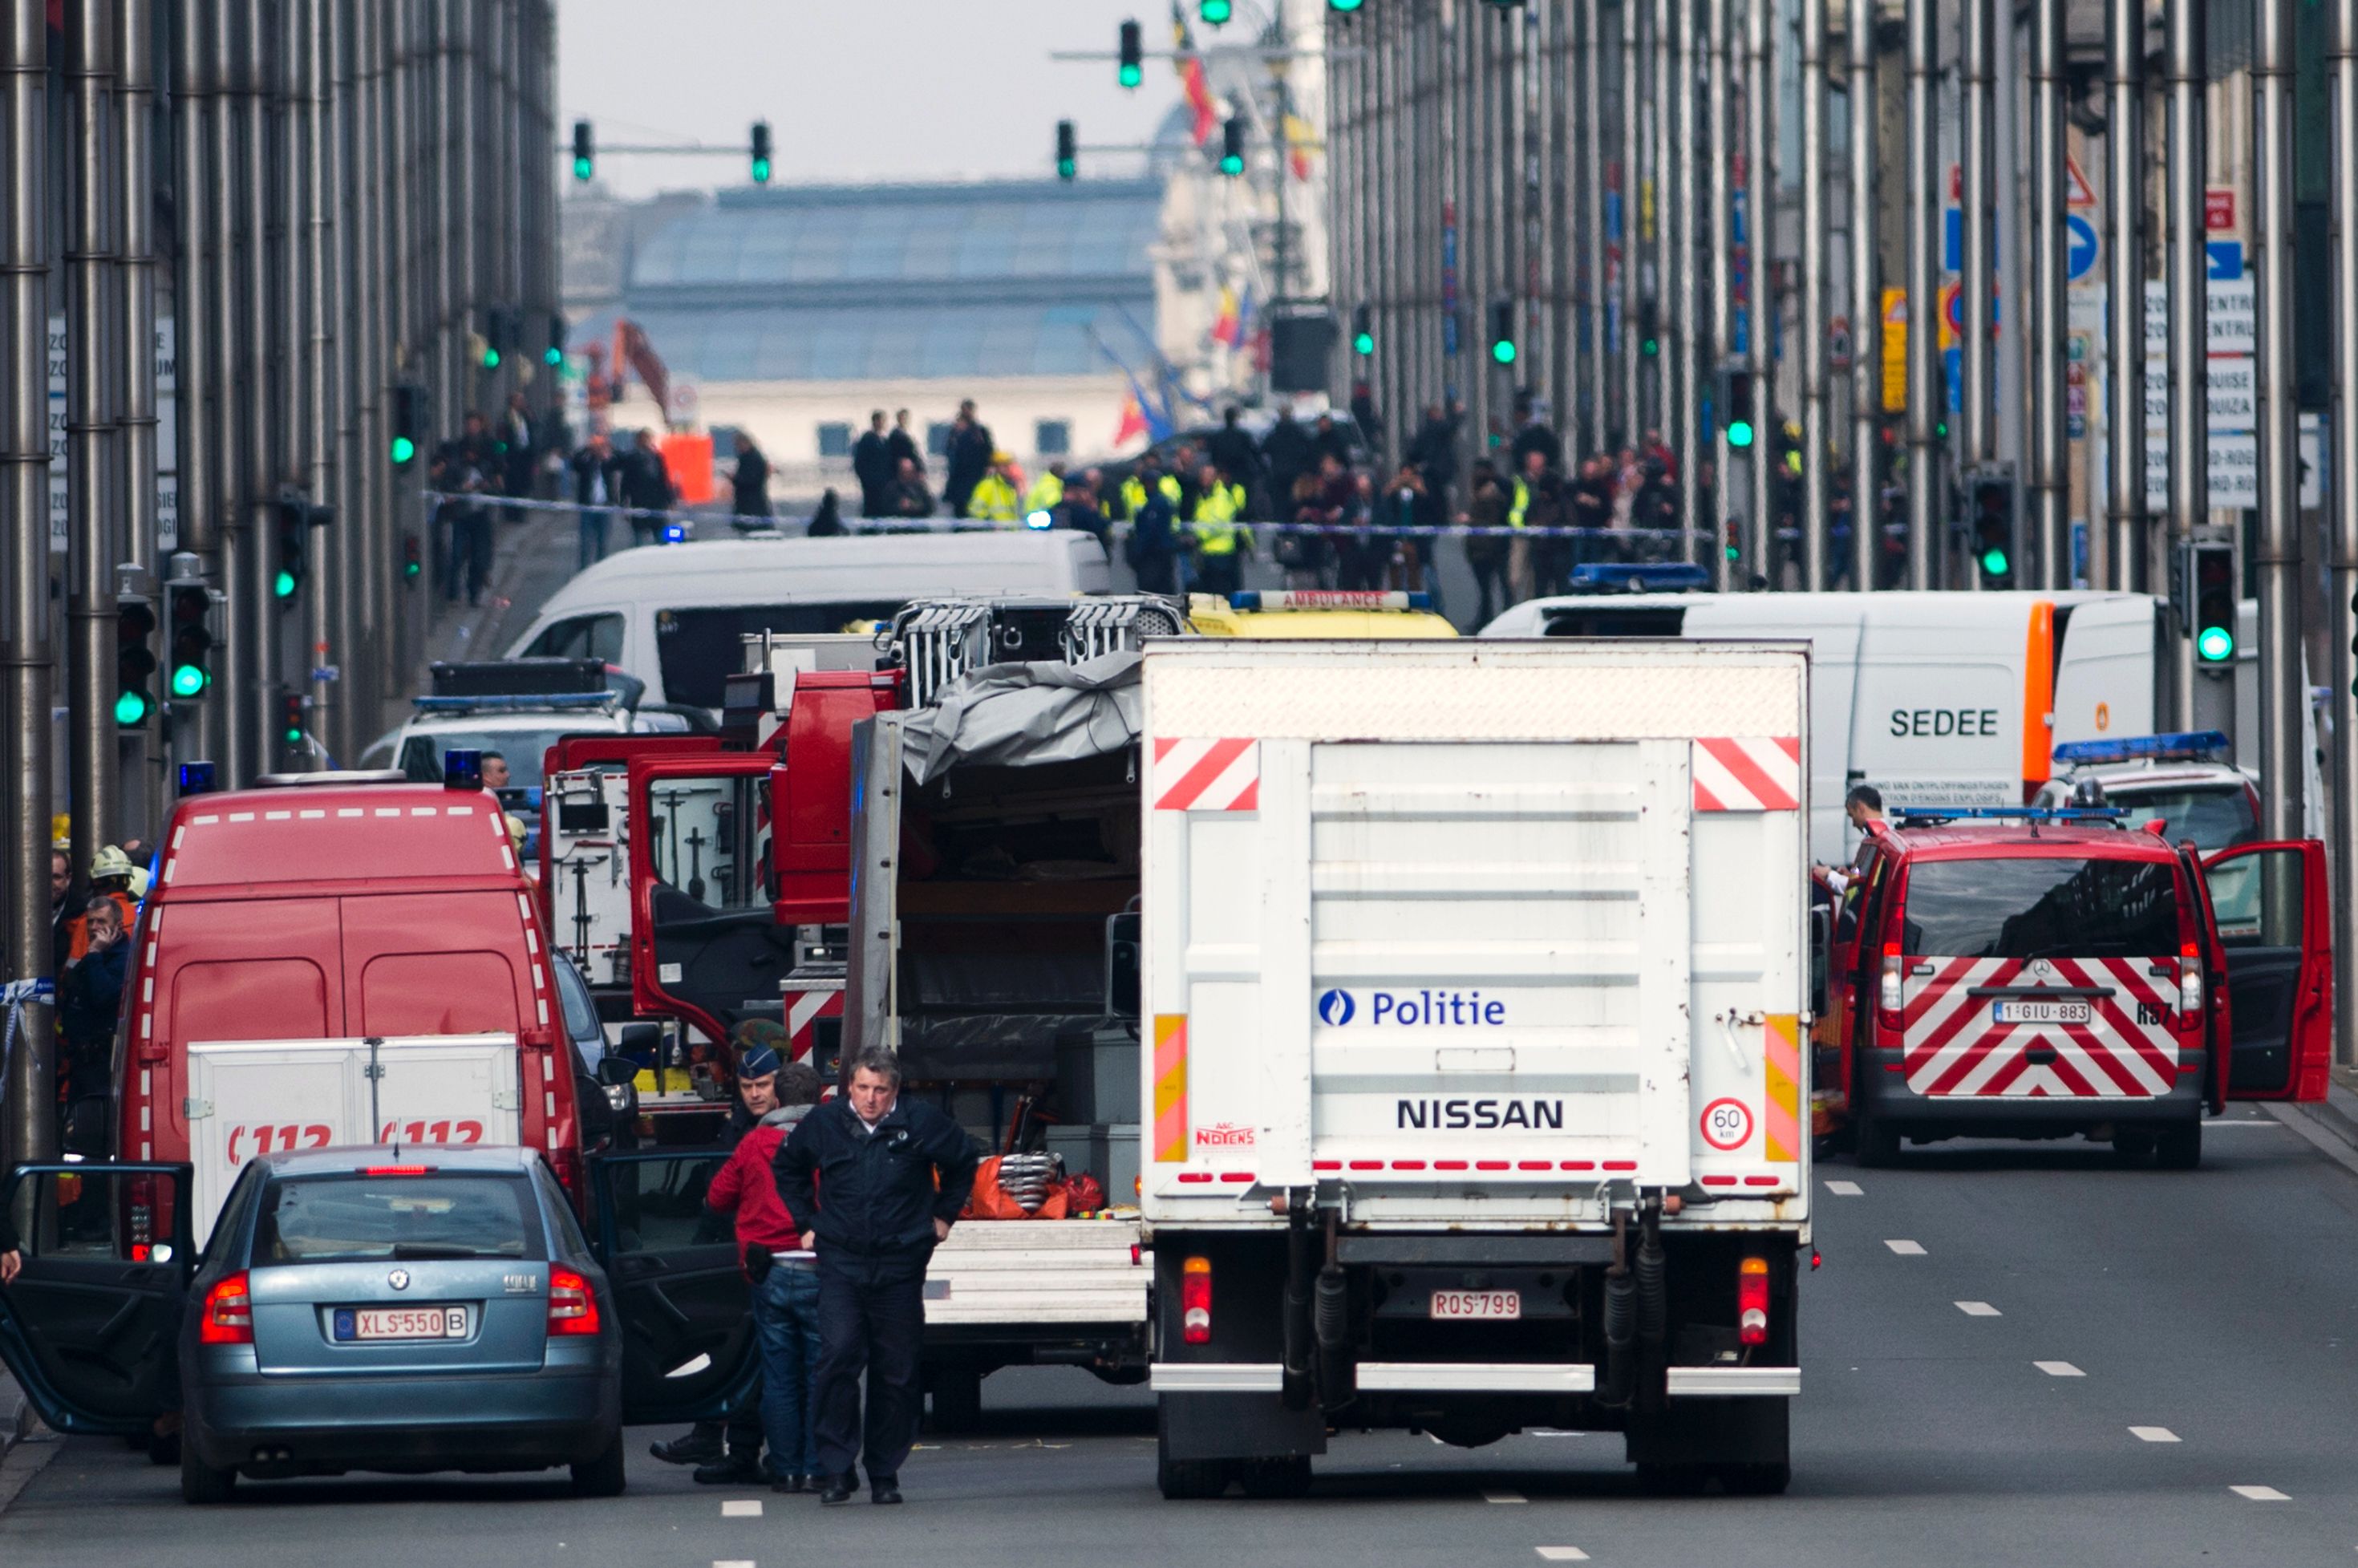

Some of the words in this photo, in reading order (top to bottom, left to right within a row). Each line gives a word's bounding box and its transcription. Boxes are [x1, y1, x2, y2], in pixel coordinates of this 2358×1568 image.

[1283, 593, 1384, 607] AMBULANCE
[1890, 709, 1999, 736] SEDEE
[1373, 990, 1505, 1025] Politie
[2137, 1003, 2173, 1026] R57
[1398, 1100, 1563, 1128] NISSAN
[1715, 1109, 1740, 1128] 60
[1720, 1128, 1734, 1138] km
[449, 1314, 464, 1330] B
